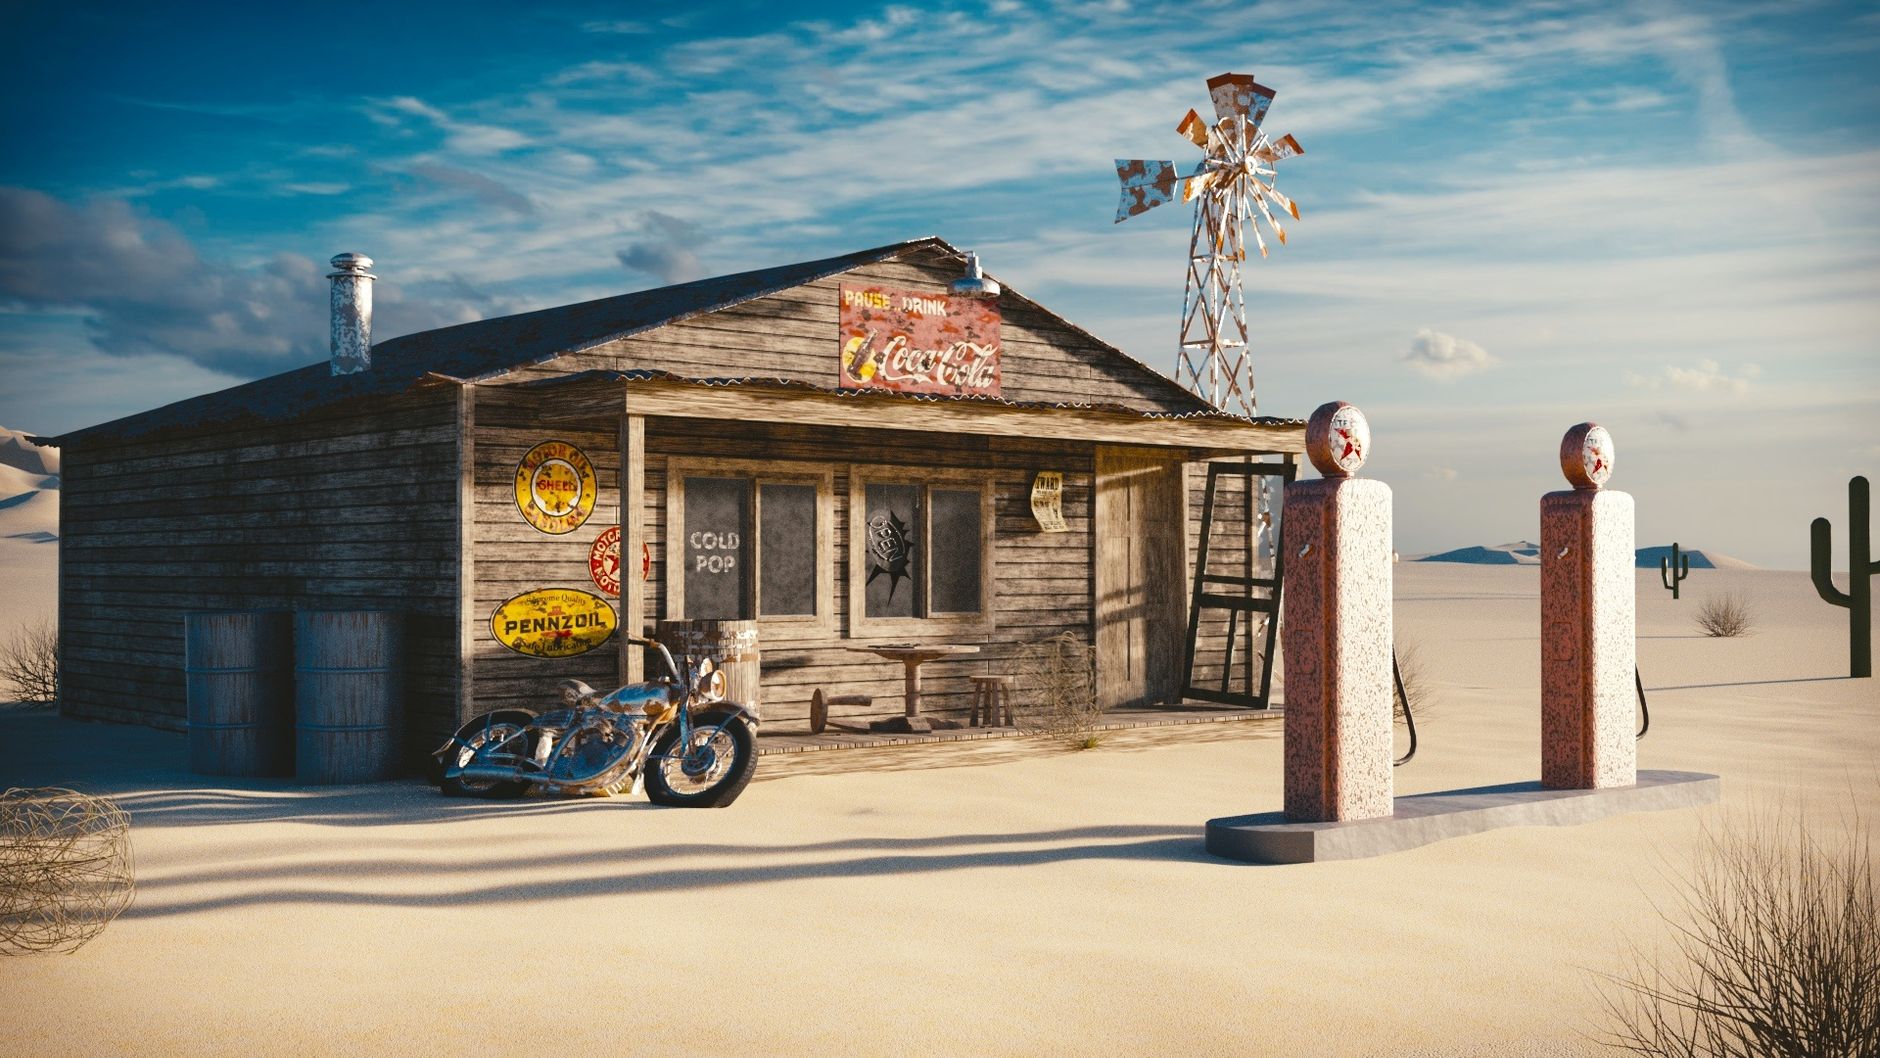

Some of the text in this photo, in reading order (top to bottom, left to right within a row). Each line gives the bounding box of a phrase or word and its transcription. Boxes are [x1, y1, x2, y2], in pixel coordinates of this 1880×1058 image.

[901, 296, 947, 317] DRINK
[690, 531, 740, 550] COLD
[870, 515, 903, 562] OPEN
[696, 554, 736, 574] POP
[505, 612, 606, 635] PENNZOIL
